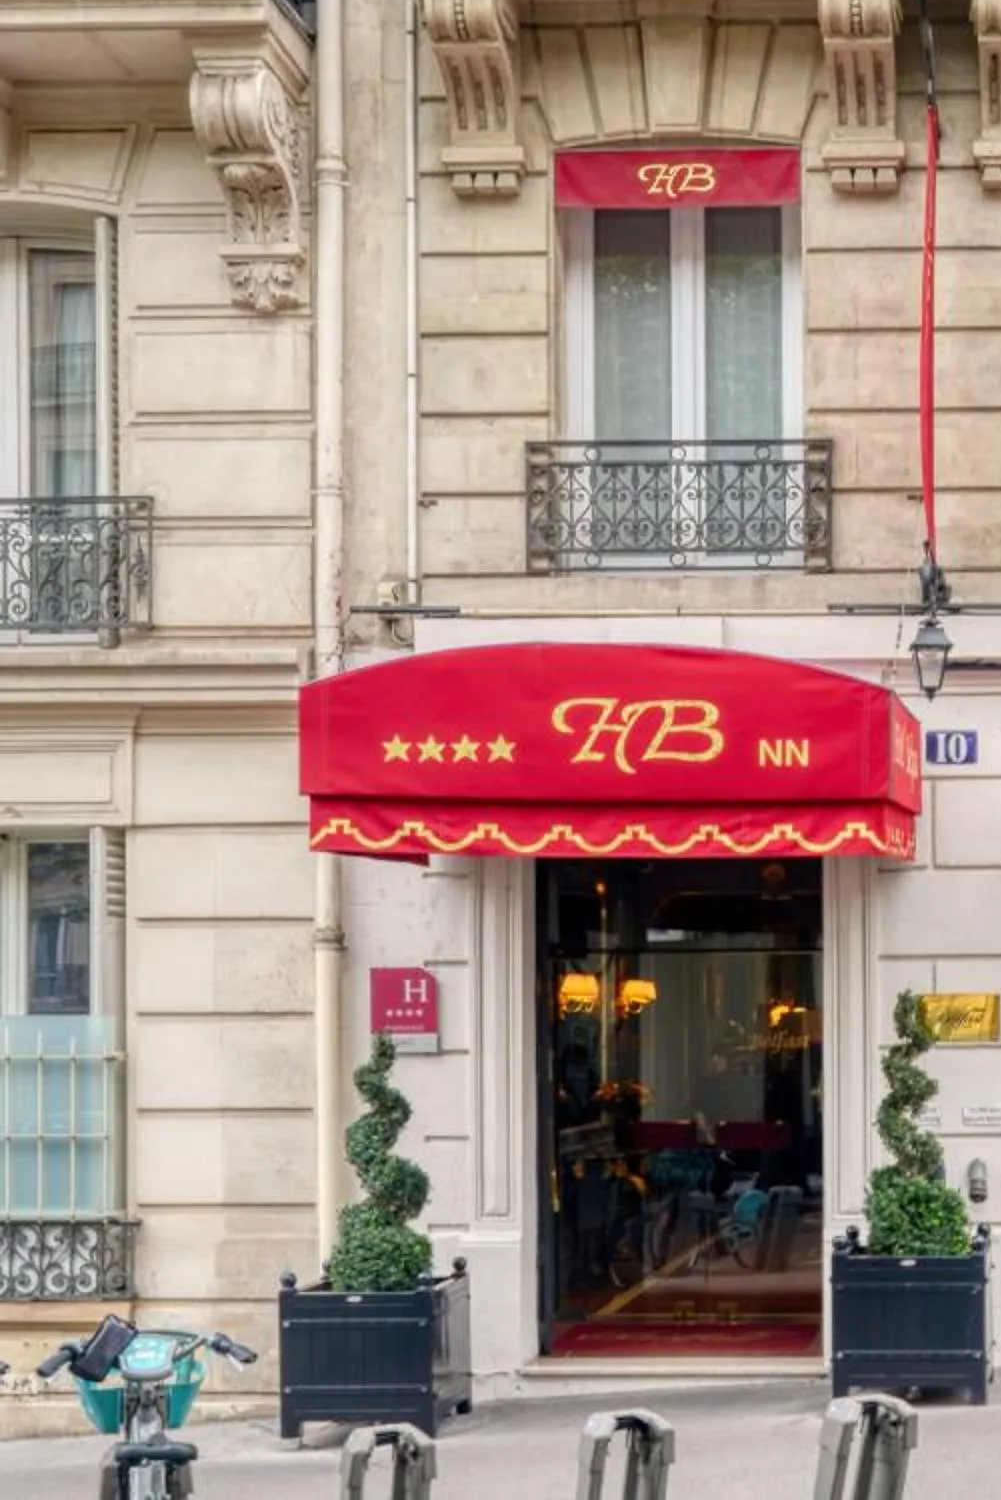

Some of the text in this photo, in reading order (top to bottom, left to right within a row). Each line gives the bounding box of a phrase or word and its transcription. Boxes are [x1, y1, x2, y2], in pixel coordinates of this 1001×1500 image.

[638, 163, 716, 198] HB
[552, 697, 809, 775] HB NN
[935, 732, 968, 764] 10
[404, 978, 428, 1003] H
